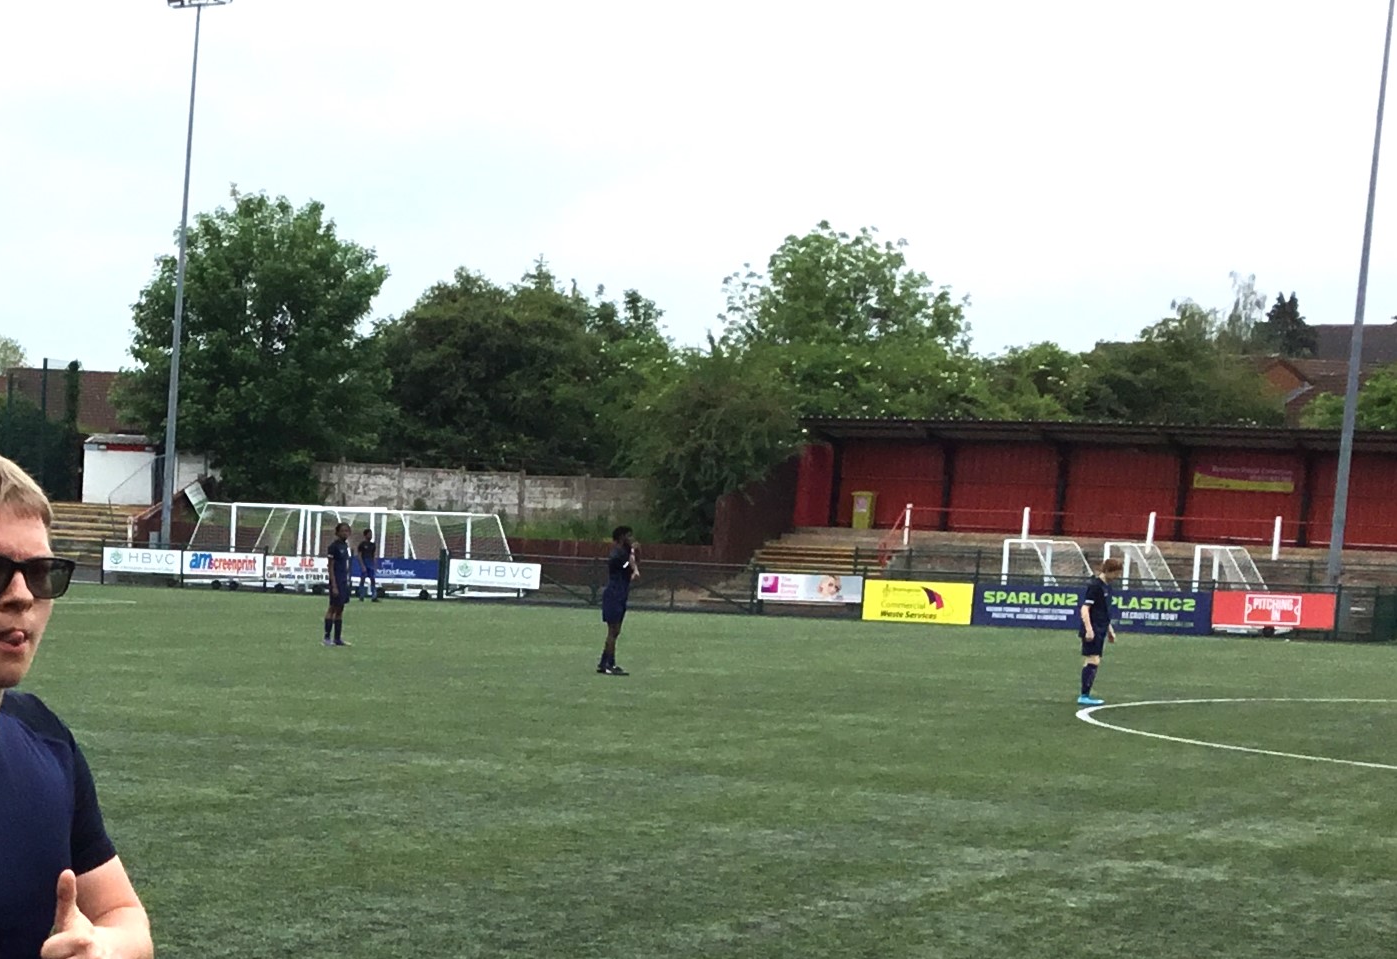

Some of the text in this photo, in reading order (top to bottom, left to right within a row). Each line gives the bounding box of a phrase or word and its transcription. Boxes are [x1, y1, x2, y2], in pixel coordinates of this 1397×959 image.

[128, 551, 175, 565] HBVC
[479, 565, 532, 580] HBVC
[1253, 598, 1293, 611] PITCHING
[881, 610, 937, 620] Waste Services
[1271, 609, 1281, 621] IN
